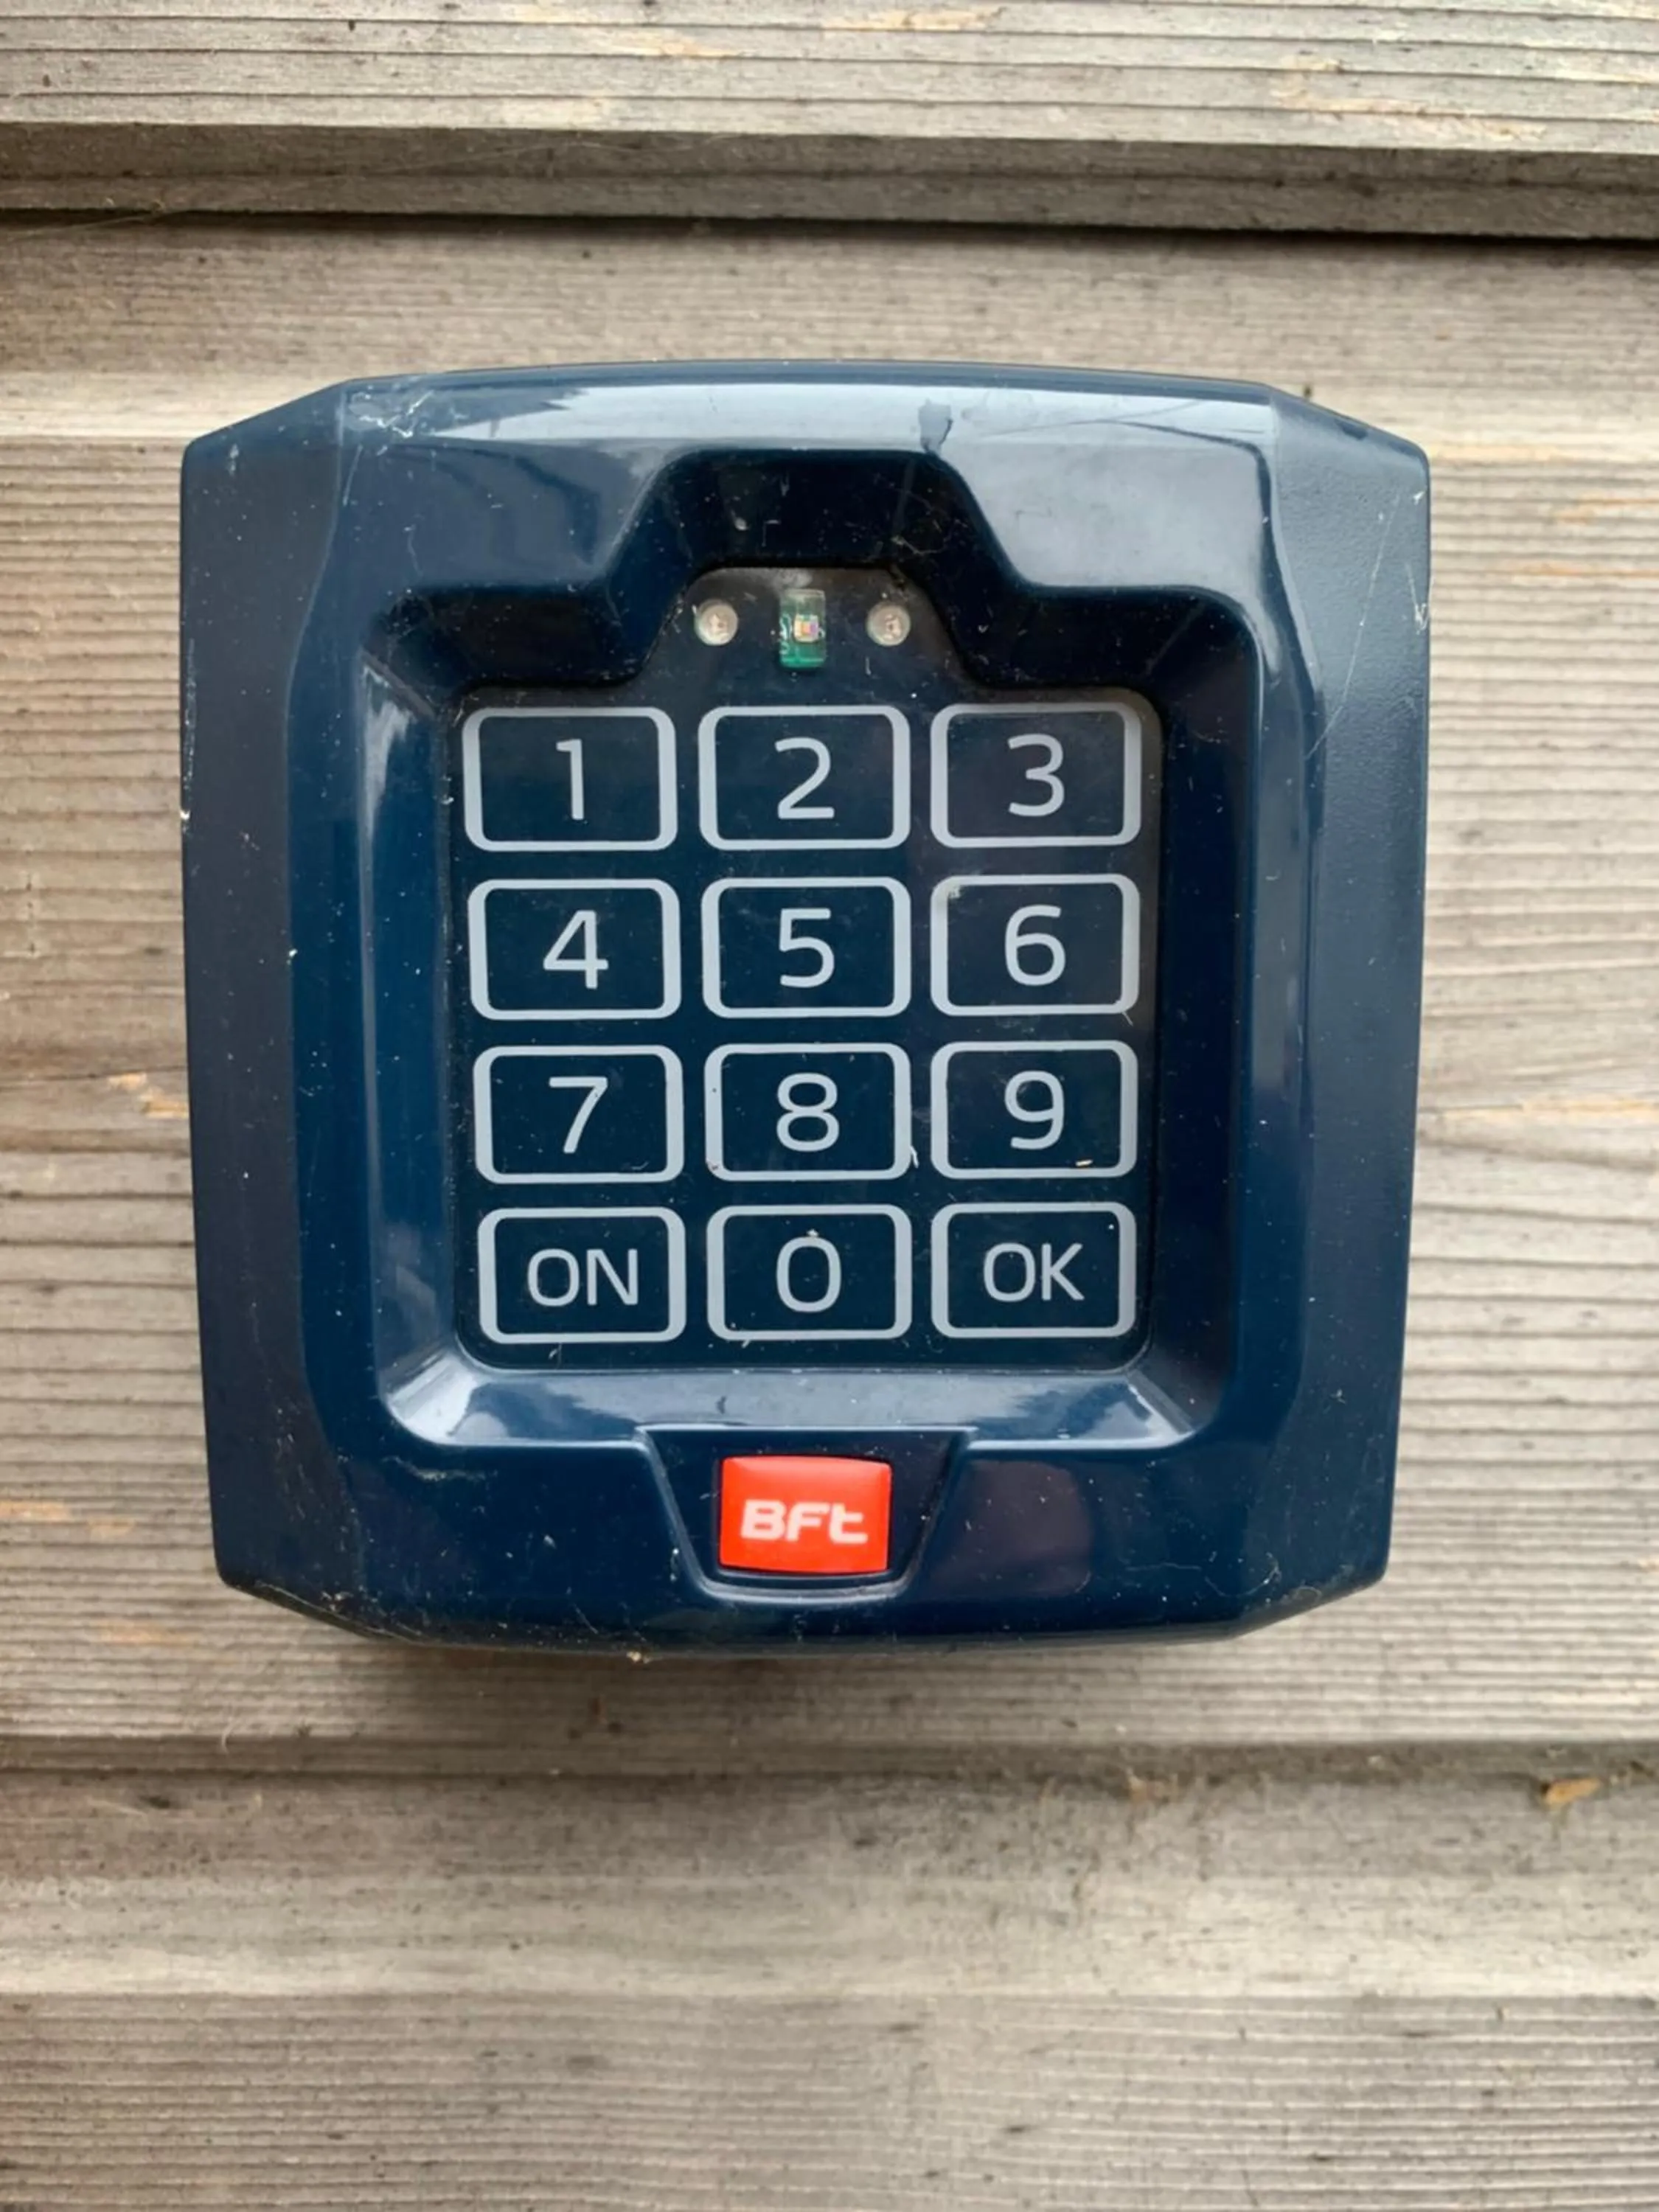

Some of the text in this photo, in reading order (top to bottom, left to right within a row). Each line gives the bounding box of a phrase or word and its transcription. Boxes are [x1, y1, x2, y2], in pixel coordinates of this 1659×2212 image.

[557, 739, 583, 820] 1
[776, 737, 834, 818] 2
[1009, 734, 1064, 816] 3
[543, 911, 608, 989] 4
[779, 908, 834, 987] 5
[1005, 905, 1065, 985] 6
[549, 1077, 608, 1153] 7
[777, 1074, 839, 1151] 8
[1005, 1071, 1064, 1149] 9
[528, 1249, 638, 1306] ON
[776, 1236, 841, 1312] 0
[984, 1243, 1084, 1301] OK
